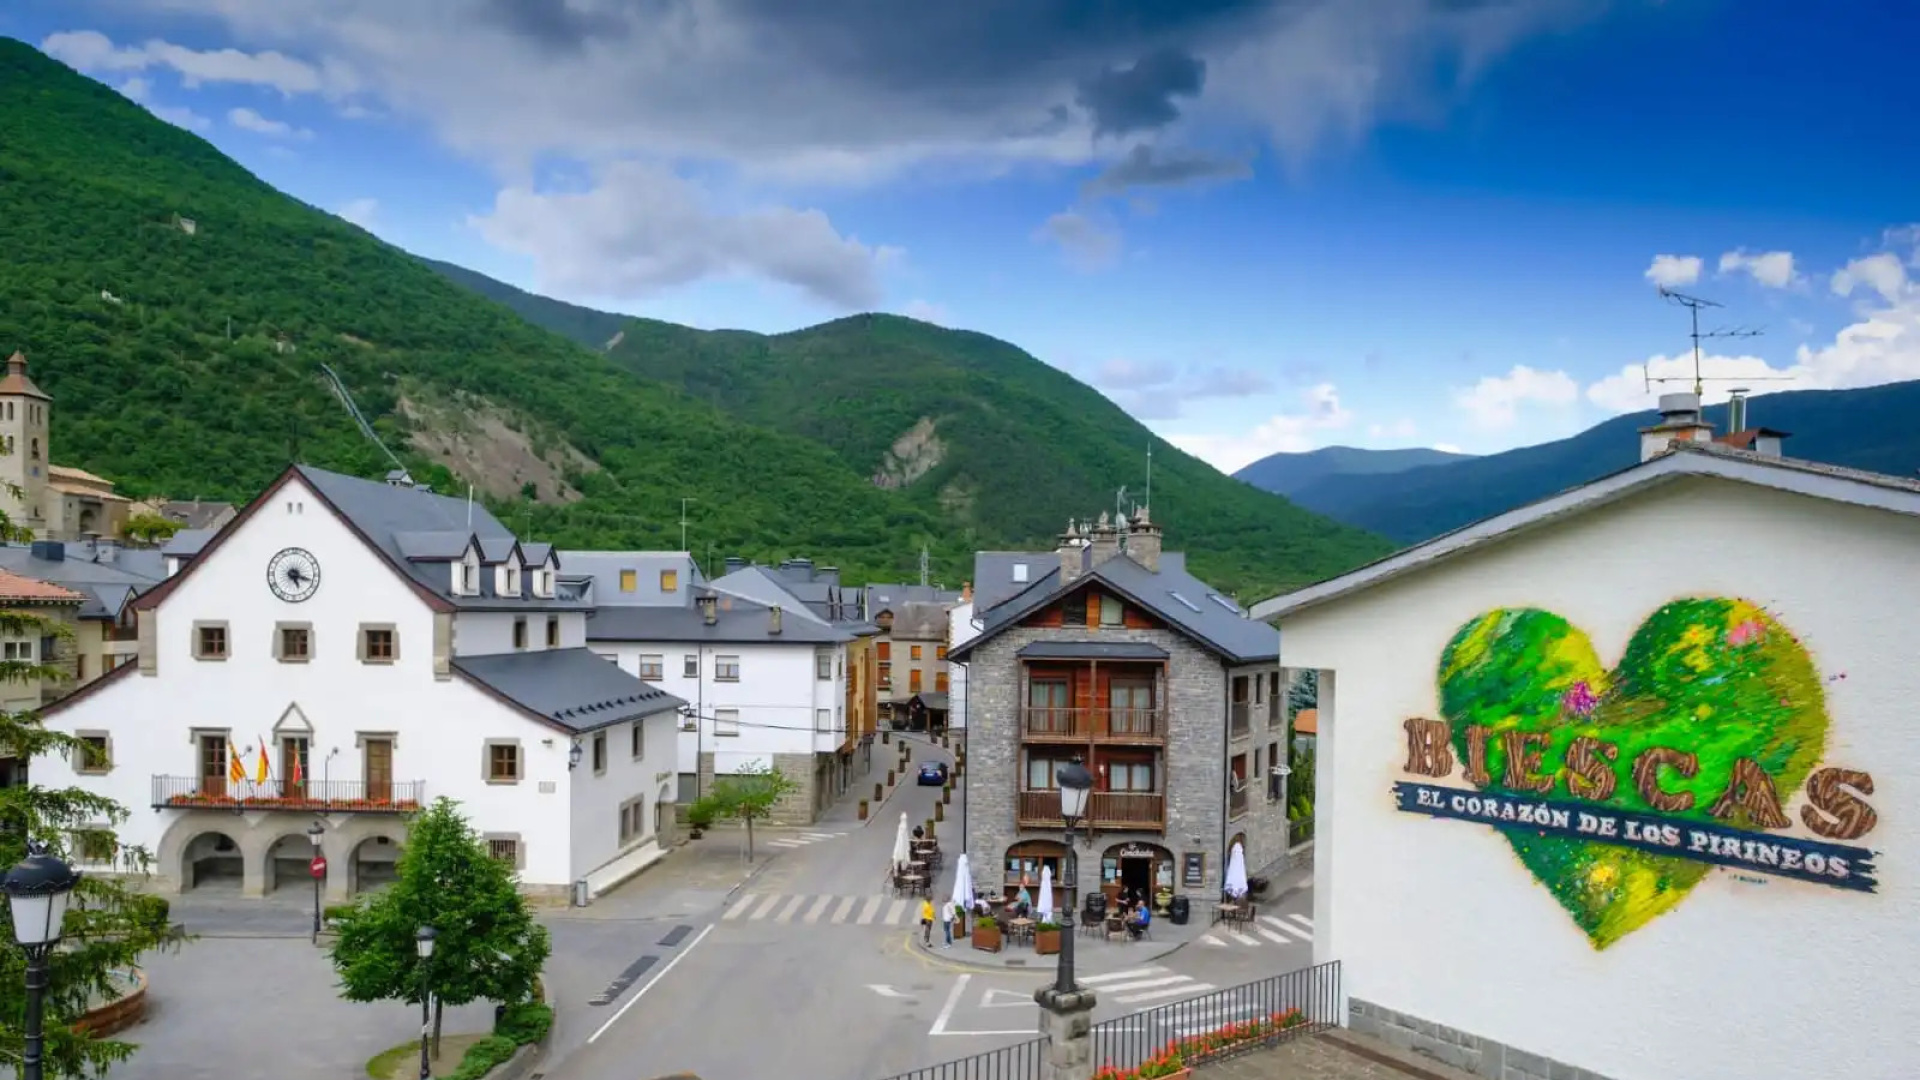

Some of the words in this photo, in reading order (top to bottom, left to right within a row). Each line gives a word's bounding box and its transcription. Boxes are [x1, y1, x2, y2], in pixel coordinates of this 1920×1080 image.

[1403, 718, 1878, 837] BIESCAS
[1417, 787, 1445, 808] EL
[1452, 795, 1571, 828] CORAZÓN
[1577, 812, 1617, 837] DE
[1623, 820, 1681, 847] LOS
[1686, 832, 1850, 878] PIRINEOS
